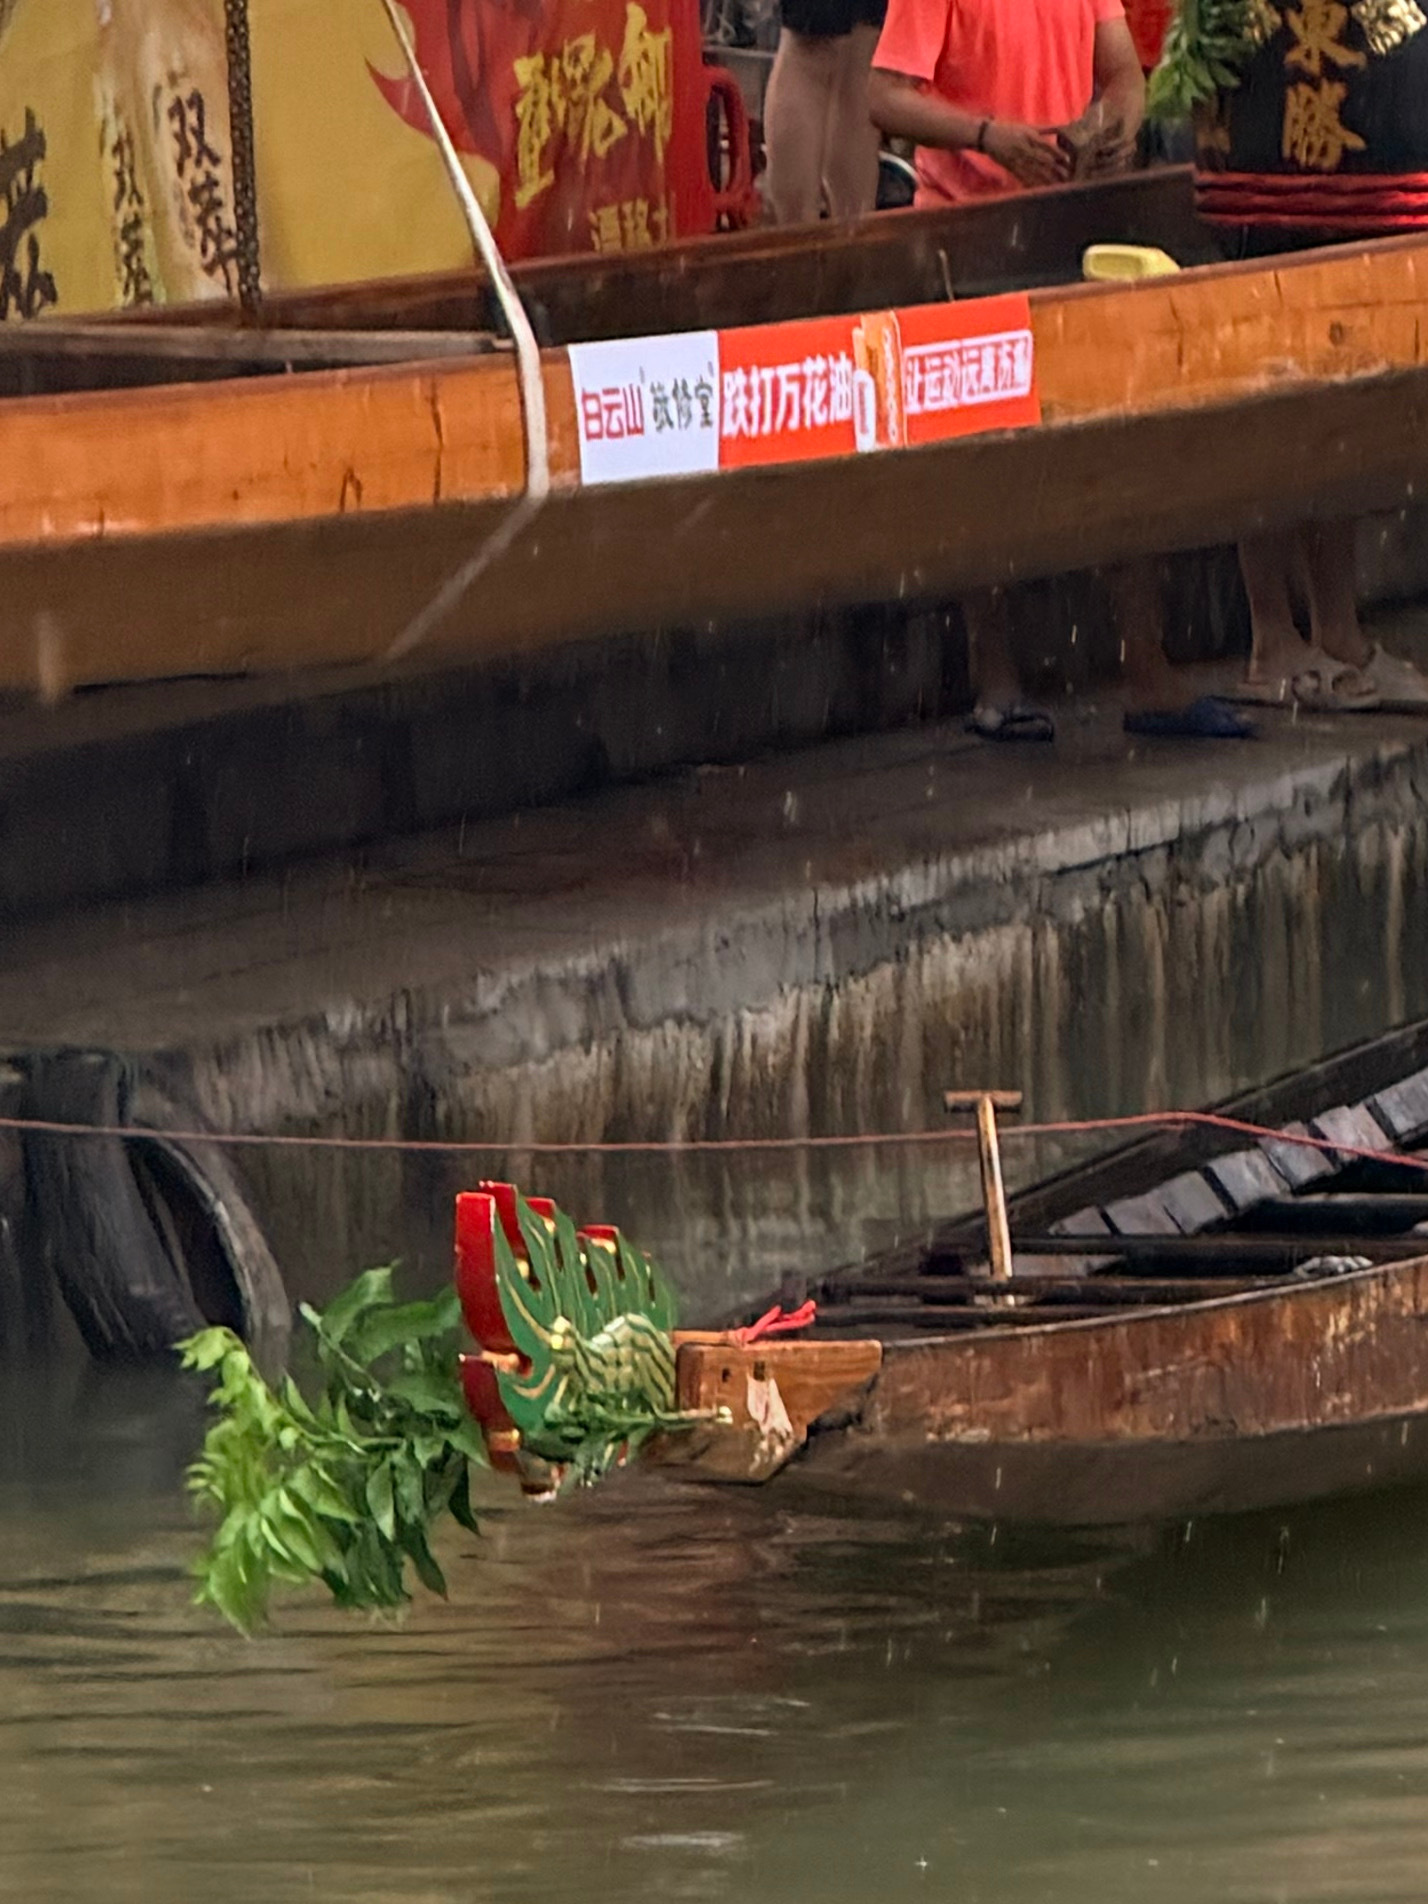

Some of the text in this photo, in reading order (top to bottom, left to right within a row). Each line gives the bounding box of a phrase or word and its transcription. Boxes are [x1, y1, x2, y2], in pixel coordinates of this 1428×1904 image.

[580, 382, 645, 441] 白云山
[722, 350, 853, 438] 跌打万花油
